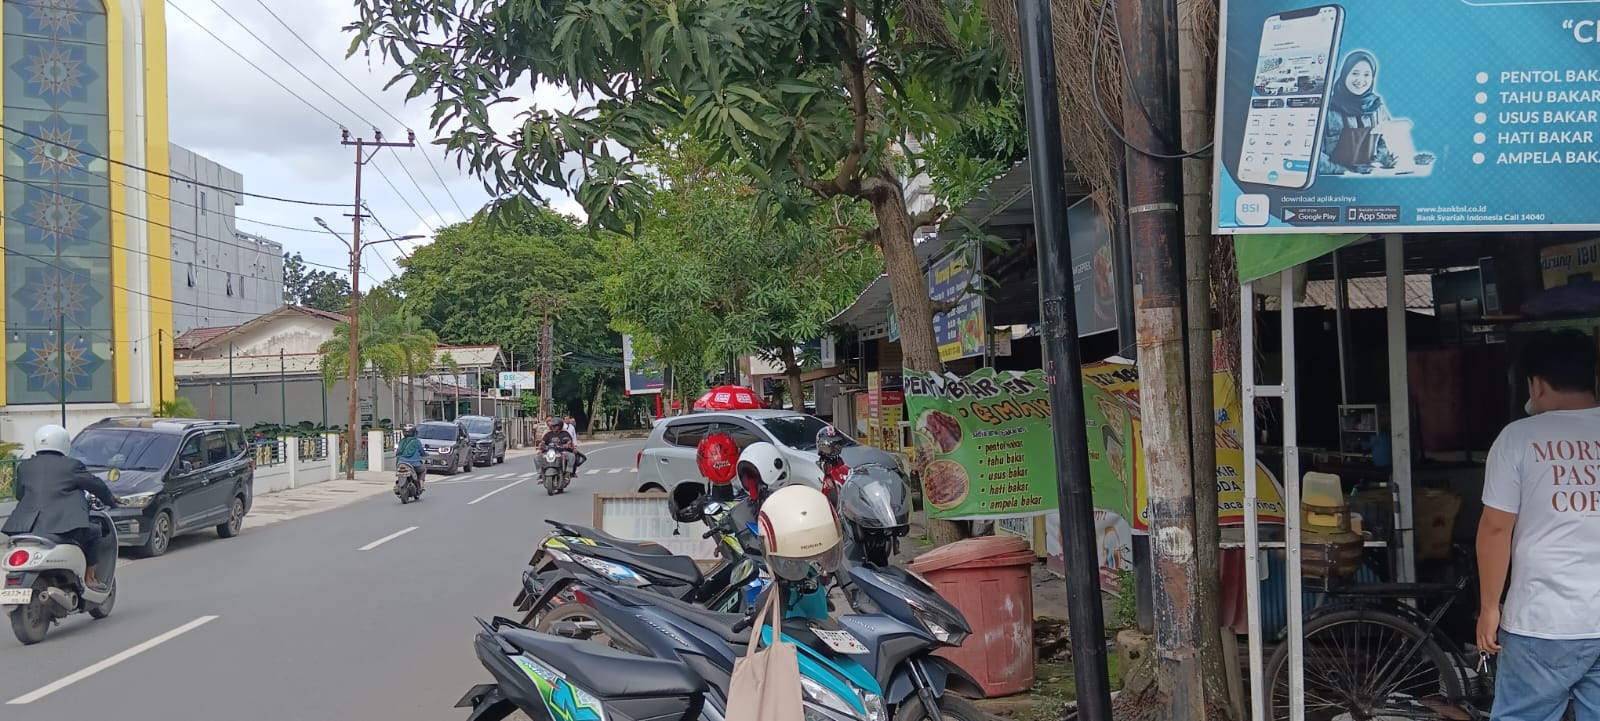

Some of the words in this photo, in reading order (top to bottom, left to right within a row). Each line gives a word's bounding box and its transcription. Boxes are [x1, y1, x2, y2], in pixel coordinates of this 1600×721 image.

[1500, 71, 1562, 83] PENTOL
[1566, 70, 1600, 82] BAK
[1499, 91, 1543, 104] TAHU
[1547, 90, 1600, 103] BAKAR
[1499, 111, 1539, 124] USUS
[1543, 110, 1598, 123] BAKAR
[1498, 132, 1534, 144] HATI
[1539, 131, 1594, 143] BAKAR
[1496, 152, 1562, 164] AMPELA
[1566, 151, 1600, 163] BAK
[1241, 203, 1260, 213] BSI
[1298, 213, 1321, 221] Google
[1323, 213, 1336, 221] Play
[1358, 213, 1376, 221] App
[987, 455, 1004, 467] tahu
[1007, 452, 1024, 464] bakar
[988, 471, 1006, 480] usus
[1009, 467, 1028, 478] bakar
[1552, 465, 1600, 485] PAS
[990, 484, 1006, 495] hati
[1008, 481, 1028, 493] bakar
[990, 497, 1018, 511] ampela
[1021, 495, 1042, 506] bakar
